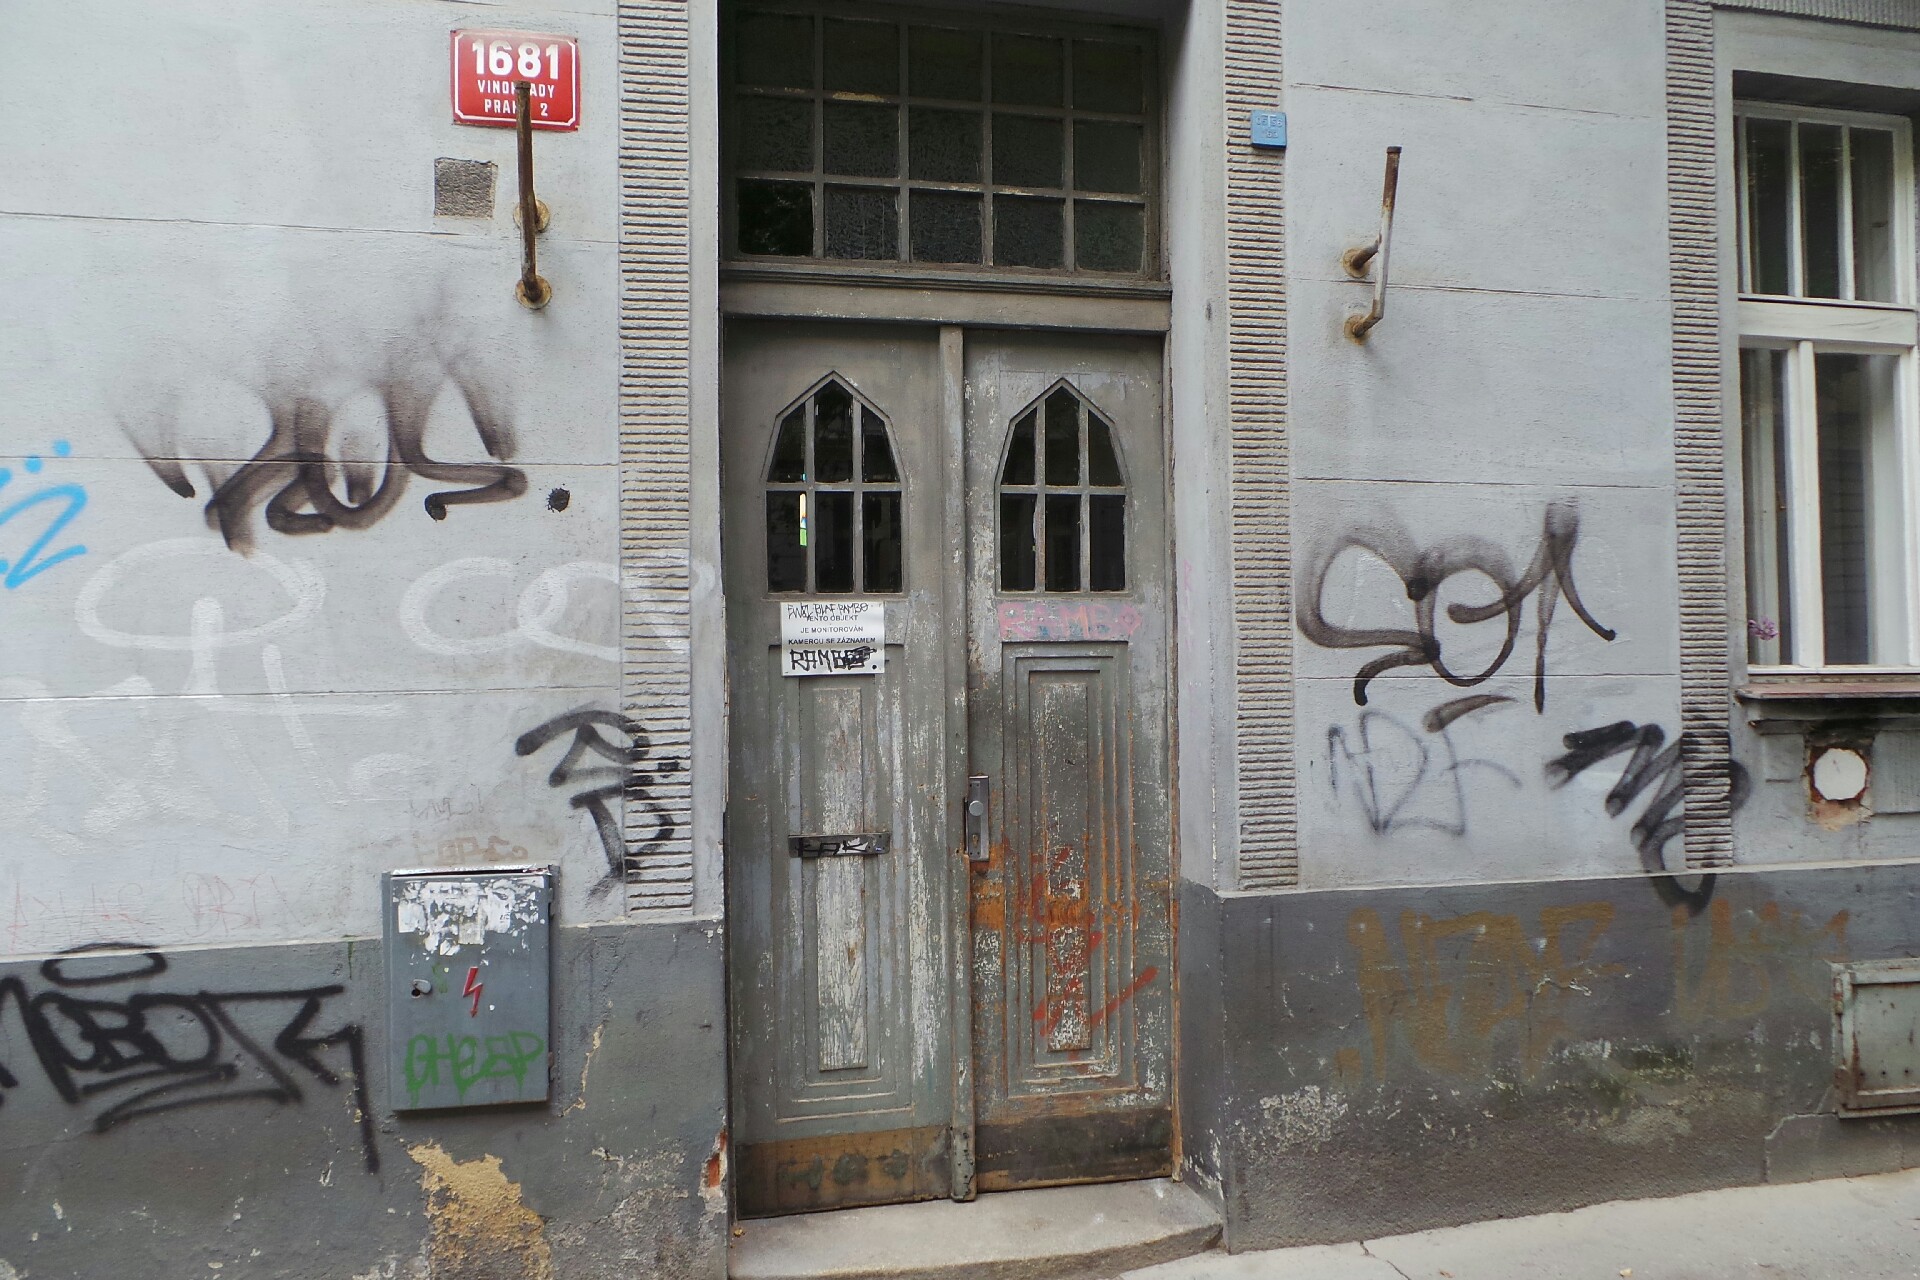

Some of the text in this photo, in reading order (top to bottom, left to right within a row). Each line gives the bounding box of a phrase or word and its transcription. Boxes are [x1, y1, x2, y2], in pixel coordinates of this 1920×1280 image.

[472, 39, 559, 80] 1681
[477, 79, 555, 99] VINOADY
[484, 99, 549, 117] PRA 2
[998, 603, 1143, 640] RAMBO
